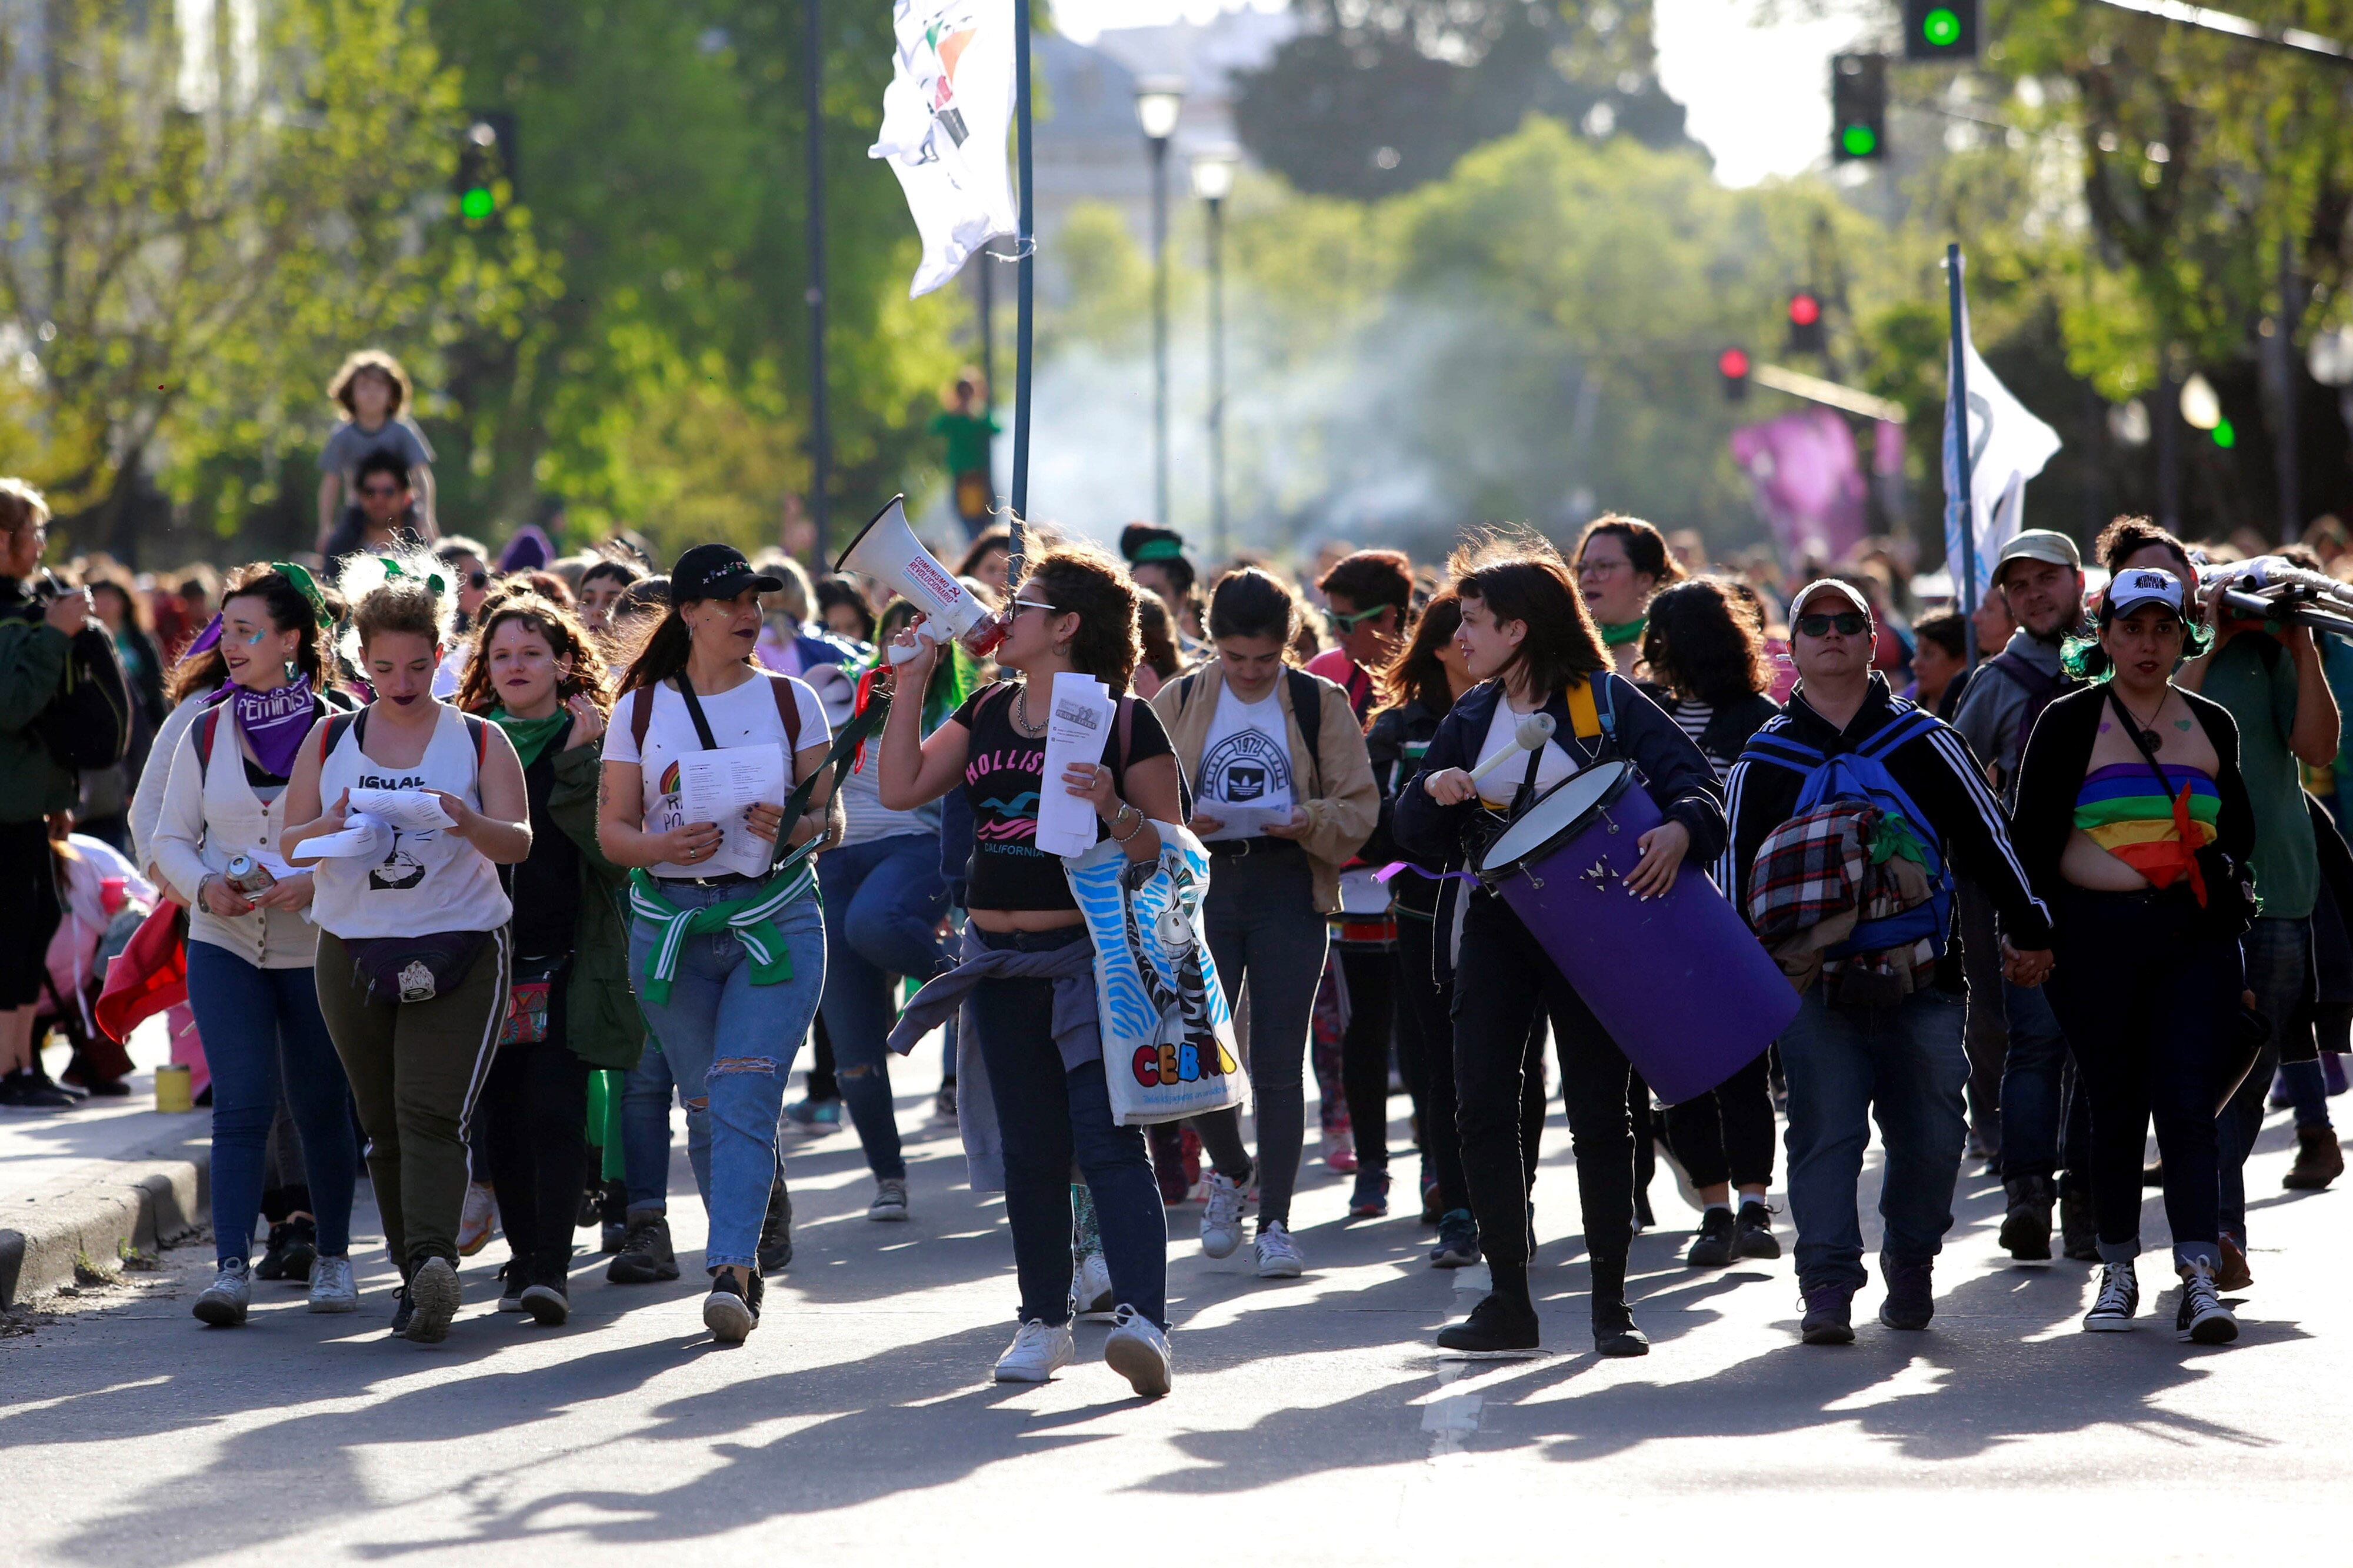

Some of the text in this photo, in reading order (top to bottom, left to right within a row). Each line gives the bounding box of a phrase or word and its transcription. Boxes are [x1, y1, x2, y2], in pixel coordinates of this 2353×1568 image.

[908, 561, 954, 603] REVOLUCIONARIO
[914, 556, 950, 588] COMUNISMO
[237, 683, 314, 721] FEMINIST
[1237, 737, 1262, 753] 1972
[358, 775, 425, 790] IGUAL
[984, 842, 1045, 858] CALIFORNIA
